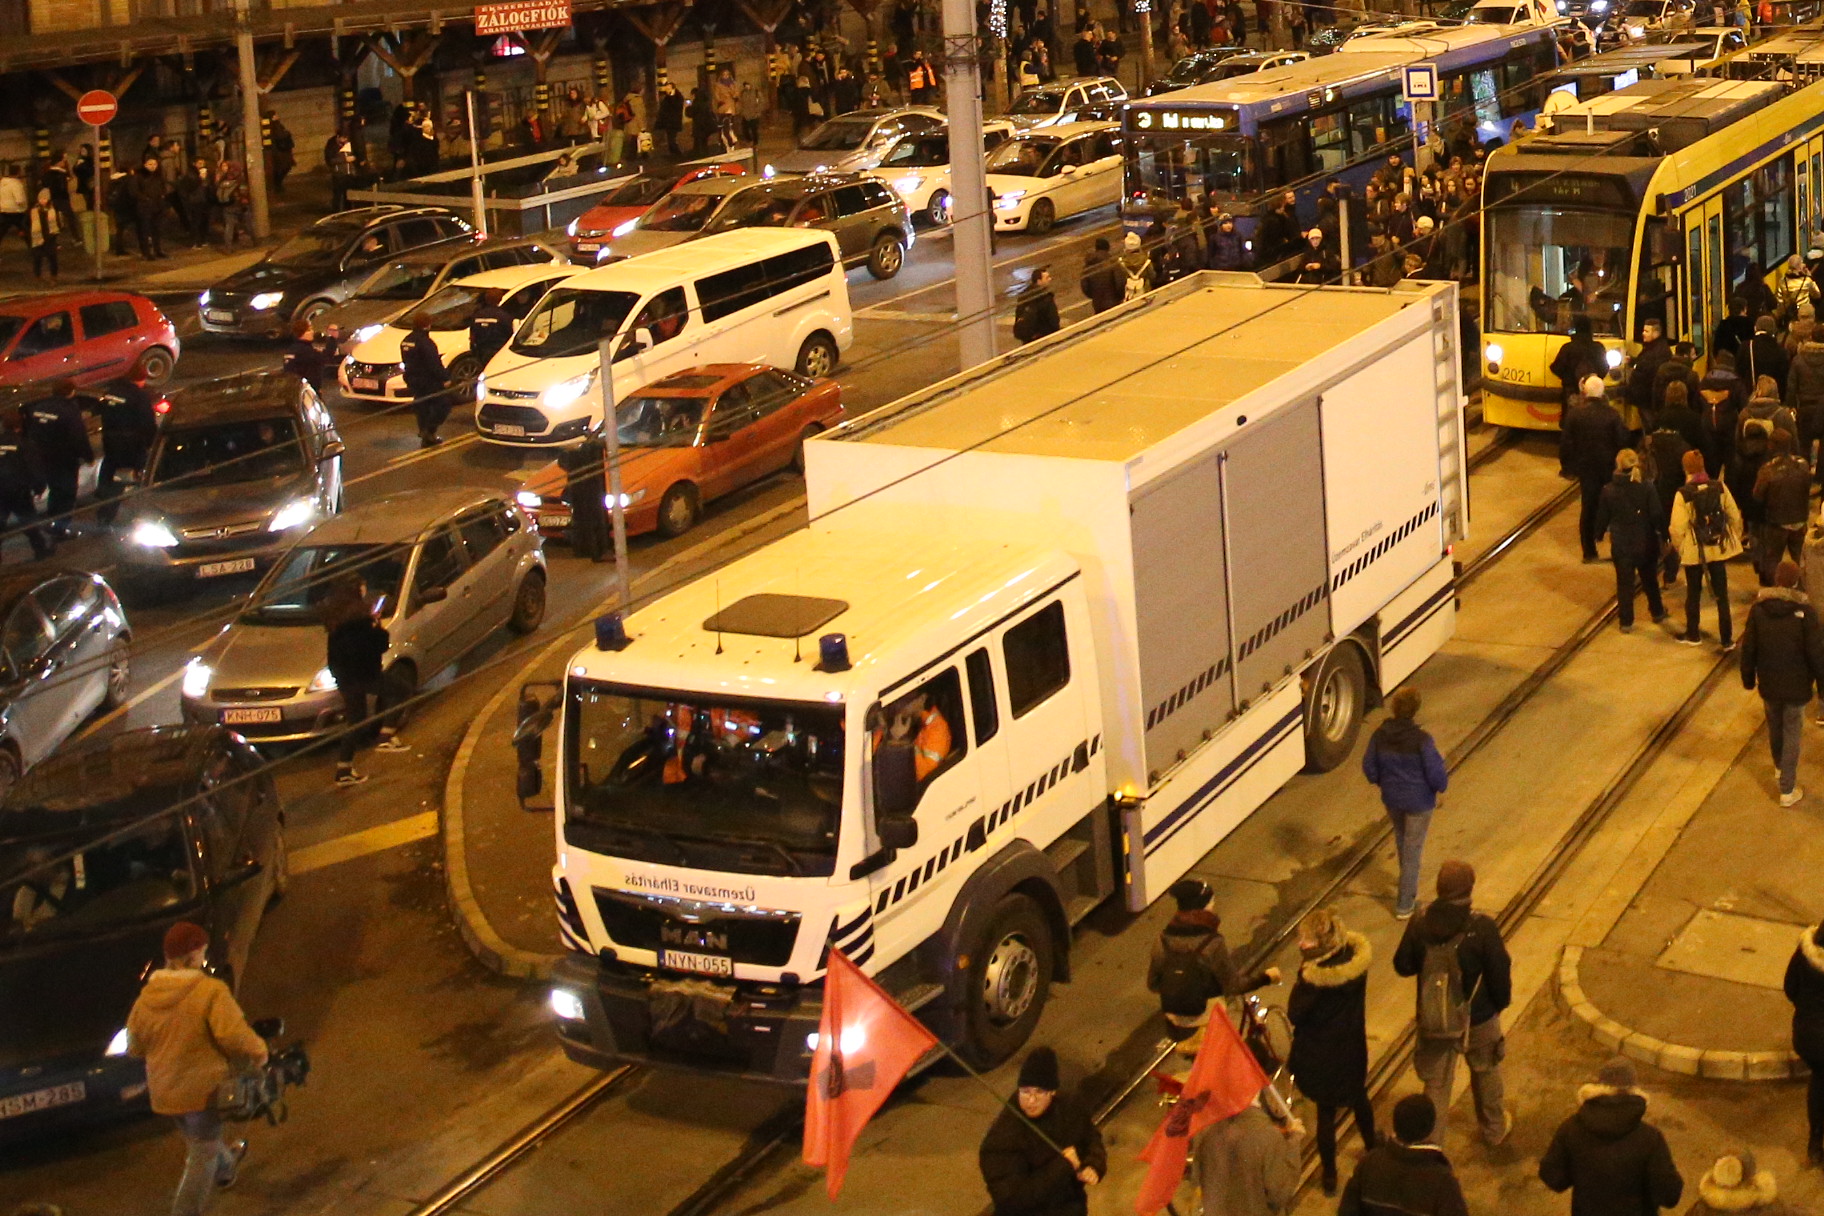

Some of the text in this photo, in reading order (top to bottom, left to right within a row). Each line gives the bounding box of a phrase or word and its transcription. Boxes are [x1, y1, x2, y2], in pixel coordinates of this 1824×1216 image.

[478, 3, 568, 28] ZÁLOGFIÓK
[1684, 184, 1697, 202] 2021
[1503, 367, 1531, 383] 2021
[660, 925, 728, 950] MAN
[667, 952, 729, 973] NYN-055
